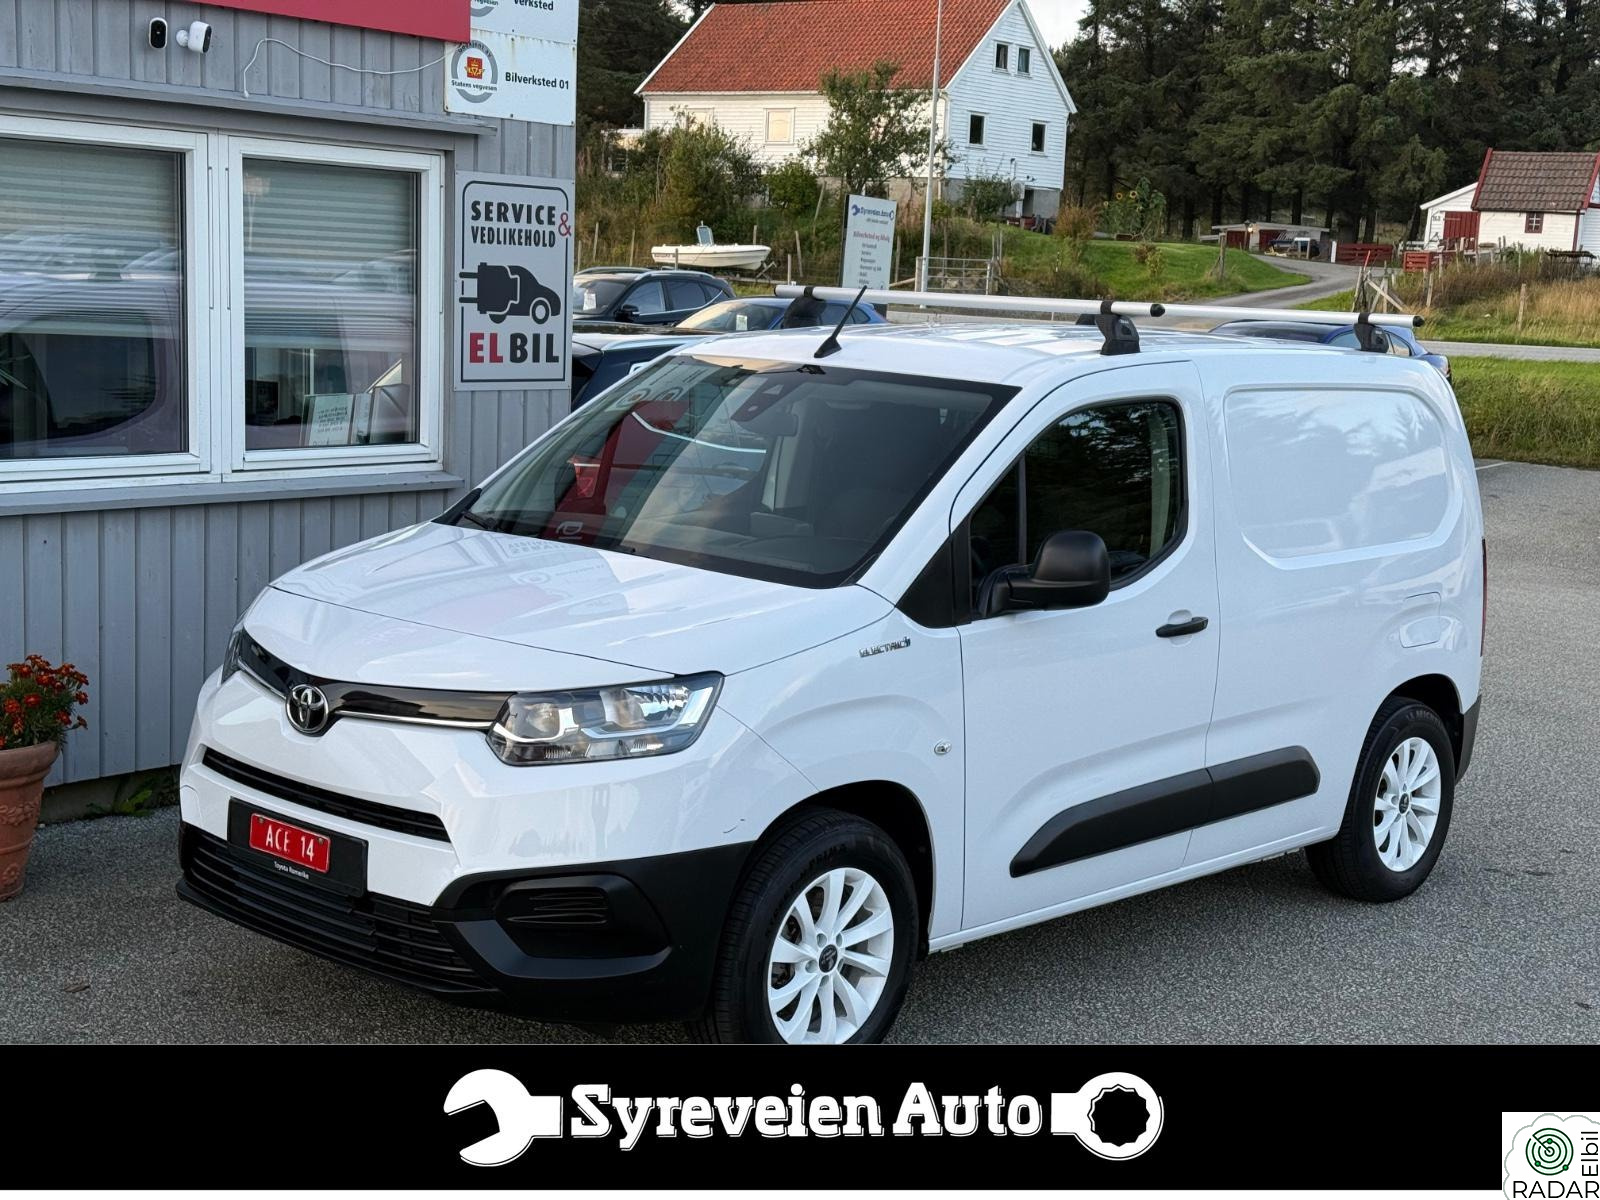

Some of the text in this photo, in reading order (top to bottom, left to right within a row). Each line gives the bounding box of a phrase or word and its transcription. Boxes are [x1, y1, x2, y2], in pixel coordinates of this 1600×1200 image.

[451, 79, 472, 88] Statens
[505, 72, 569, 90] Bilverksted 01
[471, 200, 572, 237] SERVICE &
[471, 226, 556, 248] VEDLIKEHOLD
[469, 332, 559, 363] ELBIL
[301, 836, 314, 862] 14
